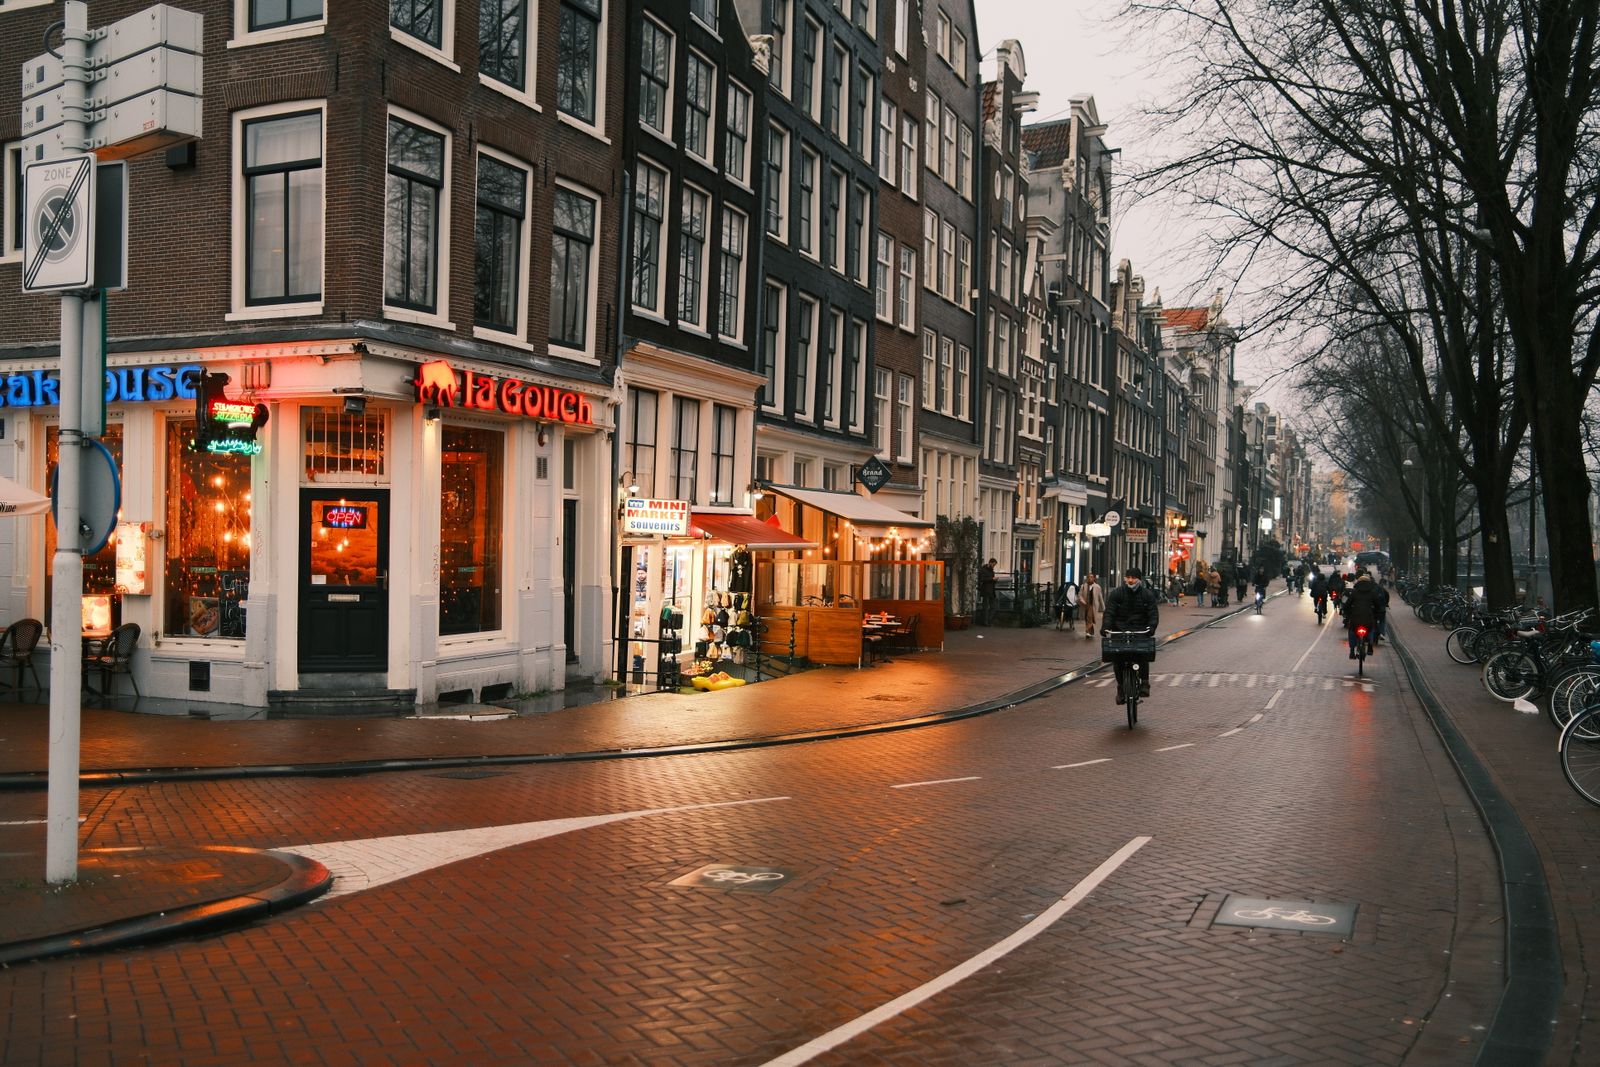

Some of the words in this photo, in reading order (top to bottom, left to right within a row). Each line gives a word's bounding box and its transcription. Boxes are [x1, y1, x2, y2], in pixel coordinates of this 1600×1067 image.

[44, 167, 72, 181] ZONE
[501, 378, 593, 425] Gouch
[862, 468, 882, 477] Brand
[649, 500, 687, 511] MINI
[327, 511, 362, 523] OPEN
[627, 509, 686, 520] MARKET
[630, 520, 680, 531] souvenirs
